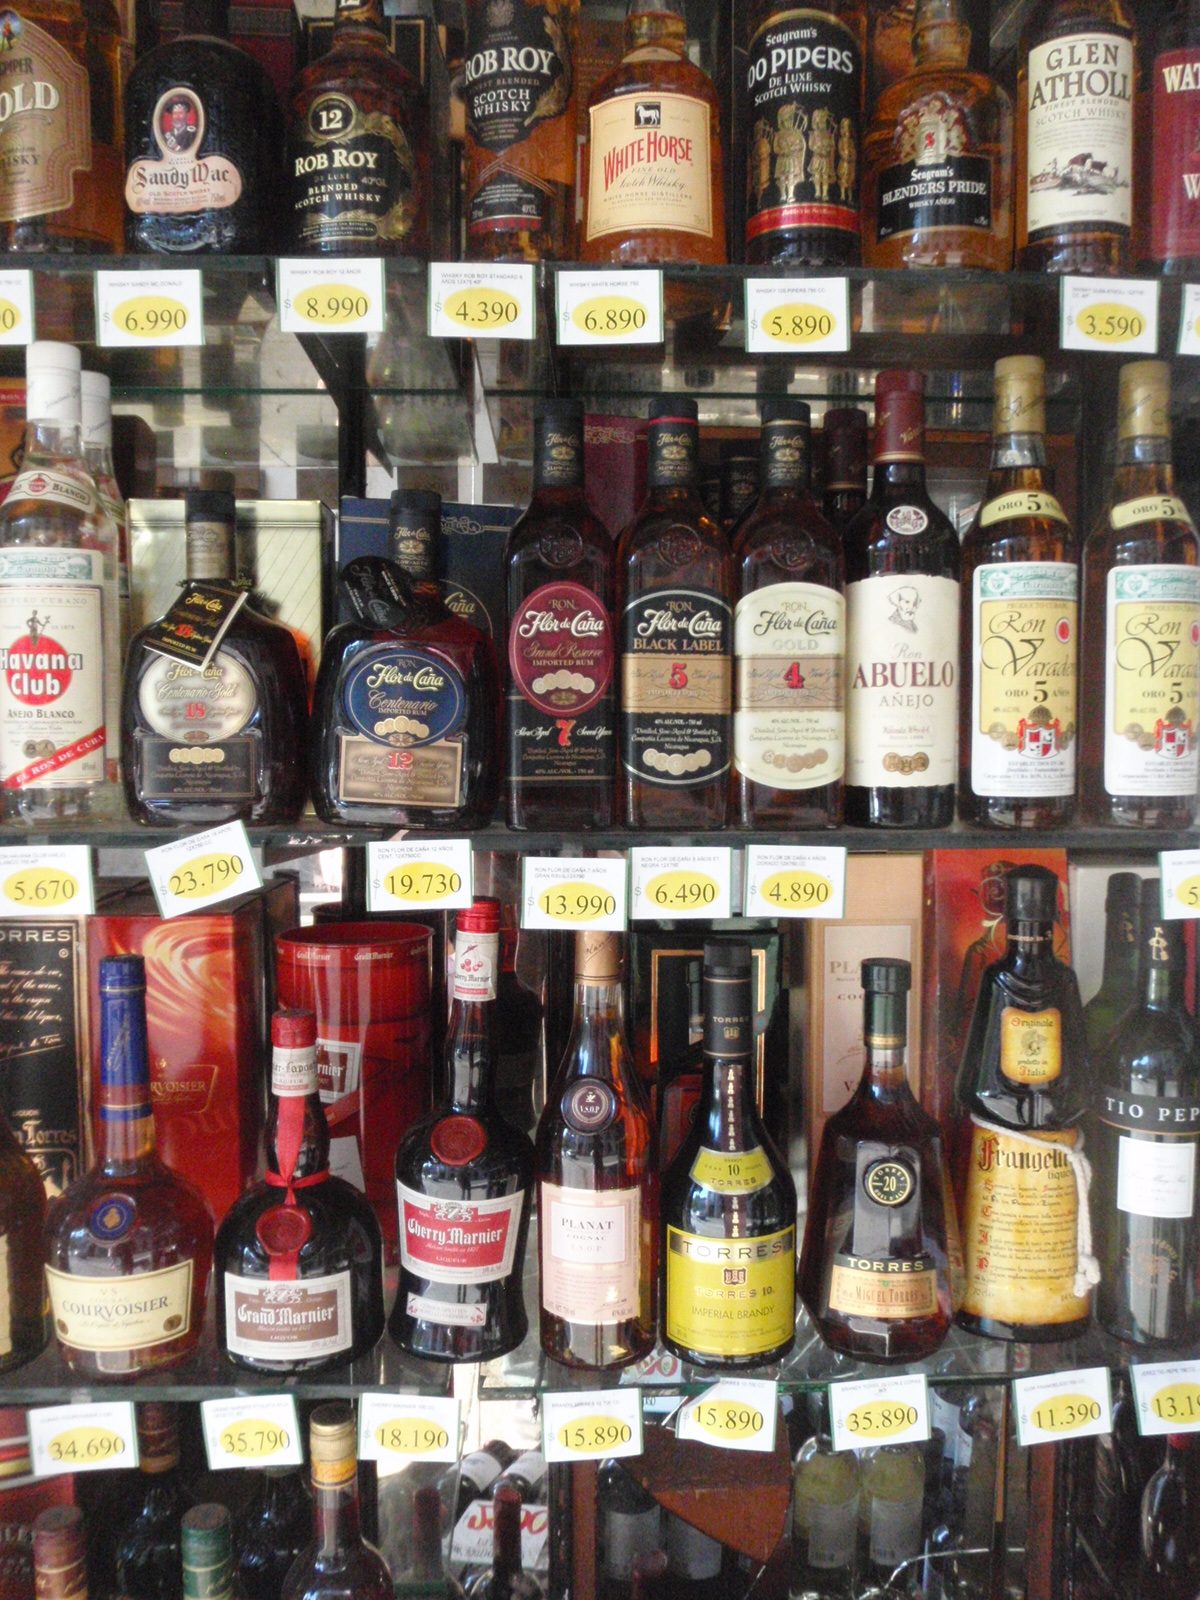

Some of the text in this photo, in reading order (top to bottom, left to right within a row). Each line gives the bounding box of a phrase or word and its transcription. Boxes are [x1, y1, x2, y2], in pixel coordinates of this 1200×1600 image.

[766, 27, 817, 46] Seagram's
[465, 47, 555, 85] ROB ROY
[770, 45, 853, 75] PIPERS
[1046, 42, 1119, 71] GLEN
[768, 71, 813, 89] DE LUXE
[1029, 69, 1131, 110] ATHOLL
[474, 88, 531, 106] SCOTCH
[754, 82, 832, 106] SCOTCH WHISKY
[319, 109, 343, 131] 12
[474, 101, 531, 119] WHISKY
[1035, 107, 1127, 126] SCOTCH WHISKY
[295, 149, 378, 177] ROB ROY
[603, 130, 693, 192] WHITE HORSE
[132, 164, 189, 192] Sandy
[910, 166, 954, 182] Seagram's
[308, 183, 358, 195] BLENDED
[881, 179, 987, 206] BLENDERS PRIDE
[295, 193, 381, 209] SCOTCH WHISKY
[306, 296, 369, 319] 8.990
[455, 301, 518, 324] 4.390
[124, 308, 187, 331] 6.990
[584, 308, 646, 331] 6.890
[771, 314, 832, 337] 5.890
[1085, 314, 1142, 338] 3.590
[996, 493, 1039, 511] ORO 5
[1132, 498, 1175, 516] ORO 5
[548, 598, 580, 611] RON
[666, 600, 697, 614] RON
[519, 610, 605, 638] Flor de Caña
[637, 609, 723, 638] Flor de Caña
[753, 609, 838, 637] Flor de Caña
[989, 610, 1046, 635] Ron
[1125, 612, 1182, 637] Ron
[633, 638, 724, 652] BLACK LABEL
[772, 638, 819, 651] GOLD
[893, 643, 923, 659] Ron
[532, 659, 595, 667] IMPORTED RUM
[852, 660, 954, 689] ABUELO
[10, 672, 62, 696] Club
[366, 663, 445, 691] Flor de Caña
[668, 662, 689, 690] 5
[783, 661, 805, 689] 4
[368, 689, 439, 711] Centenario
[879, 691, 934, 710] AÑEJO
[1004, 680, 1048, 703] ORO 5
[1141, 682, 1183, 704] ORO 5
[36, 708, 75, 720] BLANCO
[413, 709, 427, 717] RUM
[555, 719, 577, 747] 7
[57, 750, 75, 762] DE
[76, 734, 105, 753] CUBA
[386, 752, 414, 770] 12
[170, 854, 244, 896] 23.790
[388, 871, 462, 896] 19.730
[13, 878, 75, 901] 5.670
[655, 883, 716, 903] 6.490
[769, 882, 829, 903] 4.890
[543, 894, 616, 916] 13.990
[1106, 1096, 1144, 1118] TIO
[710, 1176, 757, 1187] TORRES
[727, 1163, 741, 1177] 10
[882, 1175, 897, 1192] 20
[407, 1217, 503, 1246] Cherry Marnier
[561, 1217, 614, 1230] PLANAT
[682, 1240, 784, 1260] TORRES
[847, 1256, 925, 1273] TORRES
[61, 1295, 169, 1322] COURVOISIER
[237, 1303, 336, 1325] Grand Marnier
[691, 1304, 775, 1320] IMPERIAL BRANDY
[697, 1405, 764, 1432] 15.890
[848, 1406, 919, 1432] 35.890
[1035, 1402, 1101, 1429] 11.390
[223, 1429, 291, 1453] 35.790
[379, 1427, 450, 1449] 18.190
[562, 1423, 632, 1447] 15.890
[51, 1436, 126, 1460] 34.690
